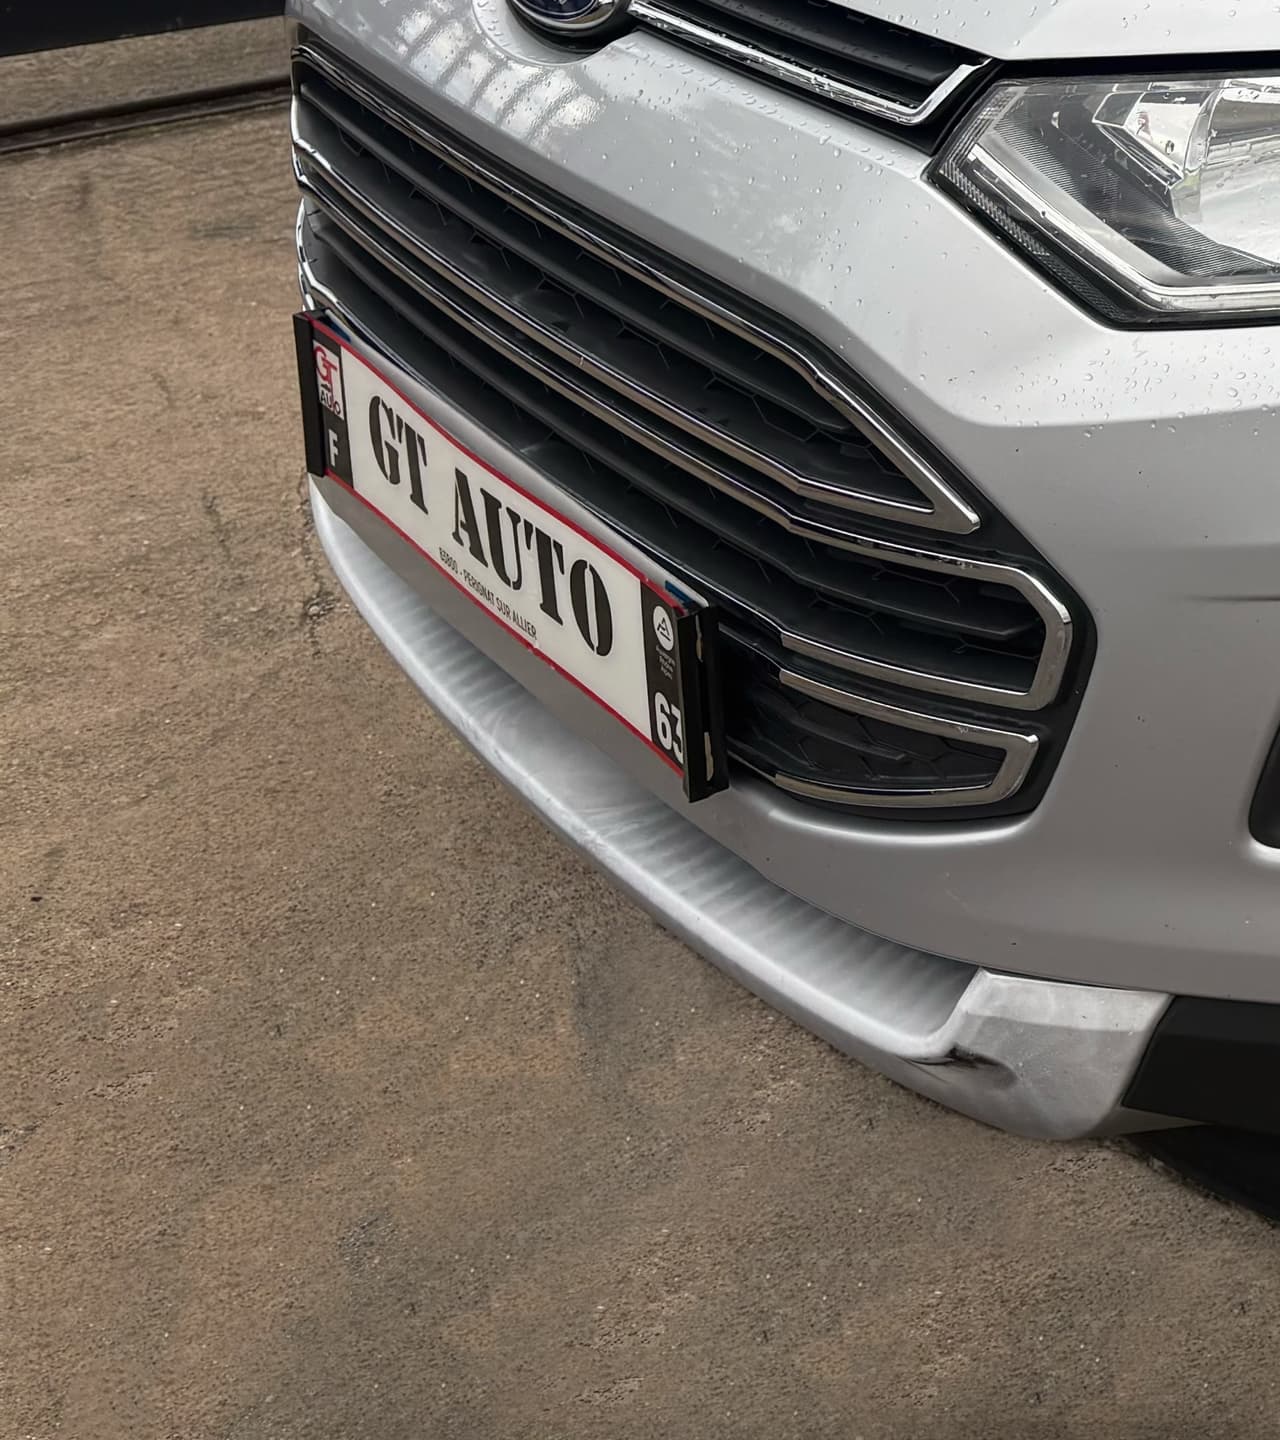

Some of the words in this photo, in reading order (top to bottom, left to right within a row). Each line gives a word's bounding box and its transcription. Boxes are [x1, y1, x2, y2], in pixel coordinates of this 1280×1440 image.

[328, 428, 339, 467] F
[368, 395, 429, 516] GT
[452, 467, 613, 657] AUTO
[496, 597, 512, 621] SUR
[513, 610, 538, 641] ALLIER
[654, 691, 684, 765] 63
